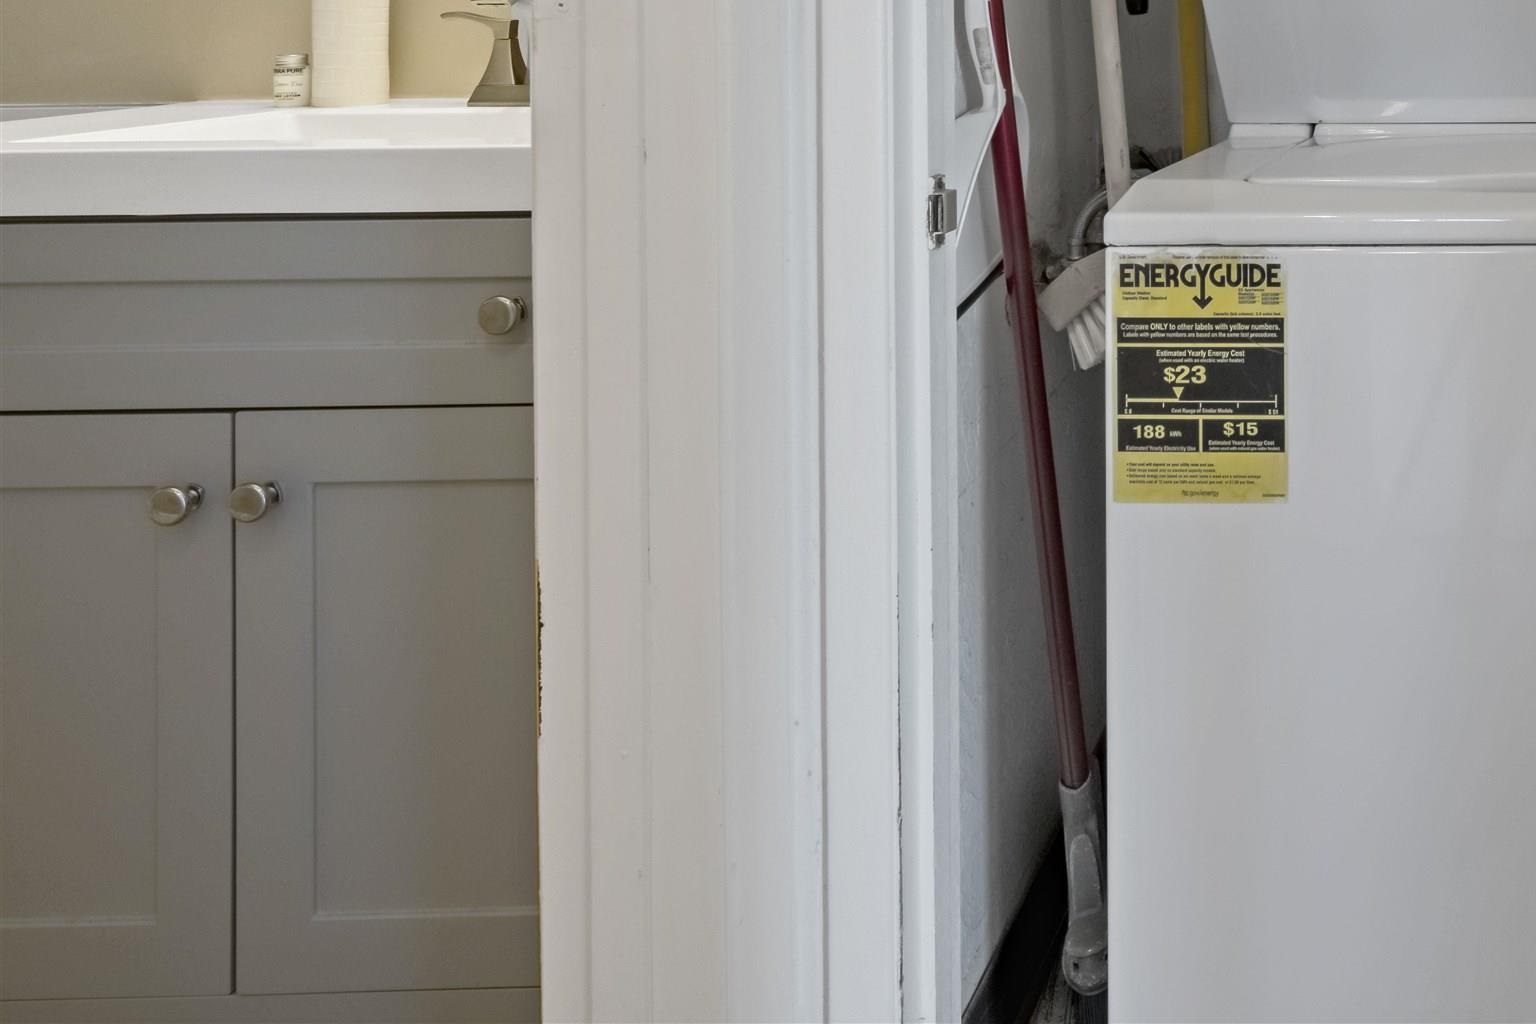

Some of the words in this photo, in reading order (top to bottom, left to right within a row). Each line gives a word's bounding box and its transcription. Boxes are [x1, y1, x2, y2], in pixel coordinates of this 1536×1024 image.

[1119, 263, 1281, 288] ENERGYGUIDE
[1120, 323, 1149, 331] Compare
[1150, 323, 1168, 331] ONLY
[1169, 323, 1176, 331] to
[1177, 323, 1194, 331] other
[1194, 323, 1214, 331] labels
[1214, 323, 1229, 331] with
[1229, 323, 1250, 331] yellow
[1250, 323, 1281, 331] numbers.
[1156, 349, 1187, 358] Estimated
[1187, 349, 1206, 358] Yearly
[1207, 349, 1230, 358] Energy
[1230, 349, 1245, 358] Cost
[1163, 365, 1207, 384] $23
[1132, 424, 1166, 439] 188
[1223, 422, 1259, 438] $15
